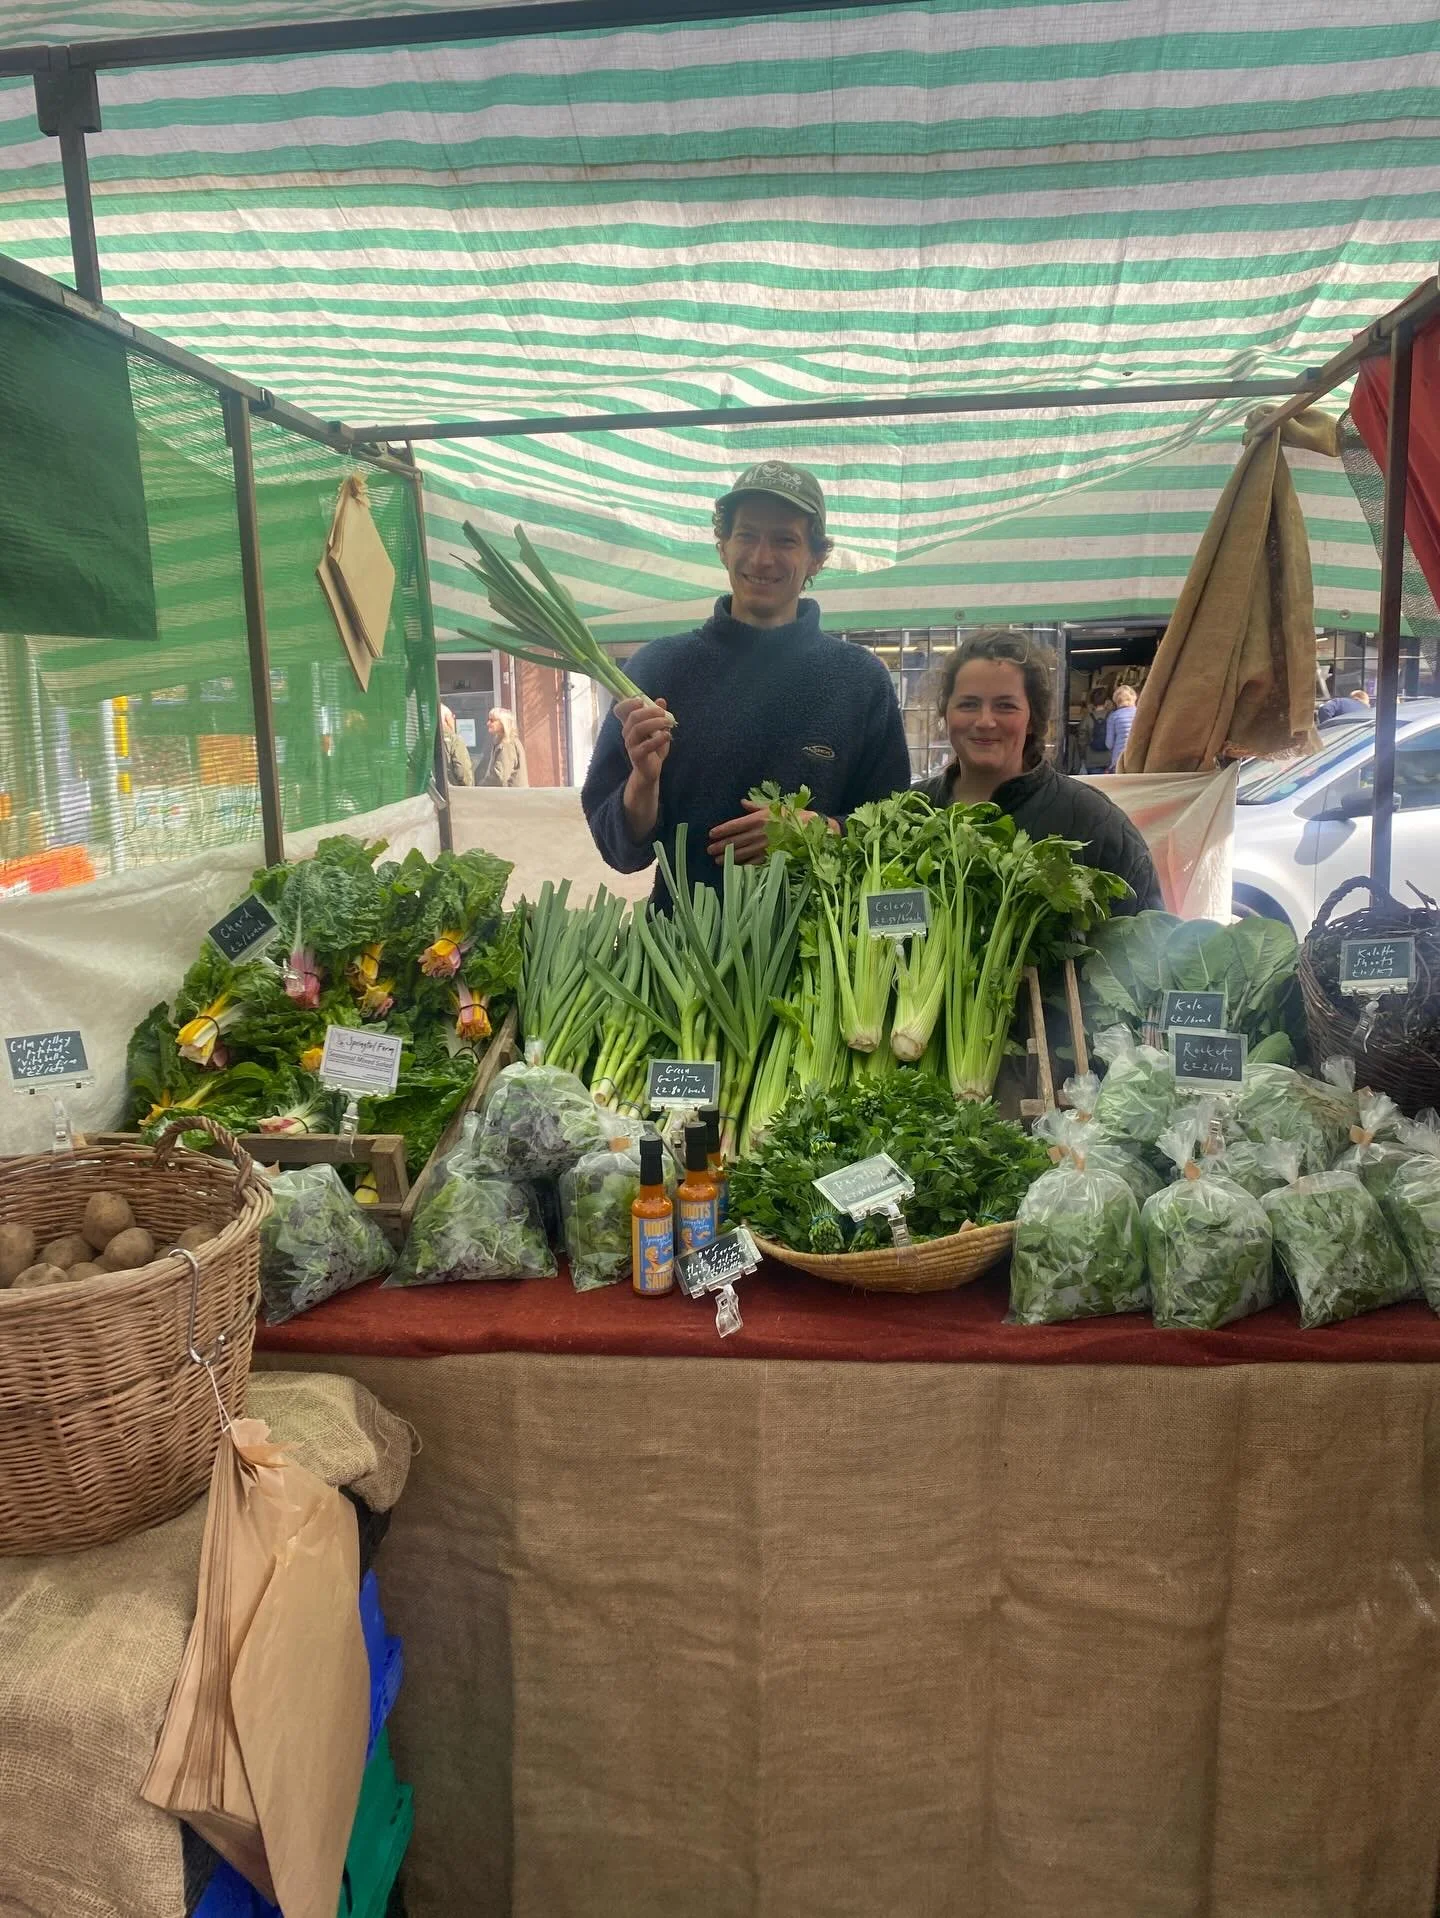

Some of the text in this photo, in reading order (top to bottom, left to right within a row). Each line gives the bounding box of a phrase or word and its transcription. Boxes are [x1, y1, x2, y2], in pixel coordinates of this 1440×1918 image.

[875, 900, 914, 917] Celery
[220, 907, 254, 939] Chard
[1174, 998, 1203, 1012] Kale
[1183, 1041, 1233, 1061] Rocket
[666, 1065, 690, 1074] Green
[657, 1074, 701, 1083] Garlic
